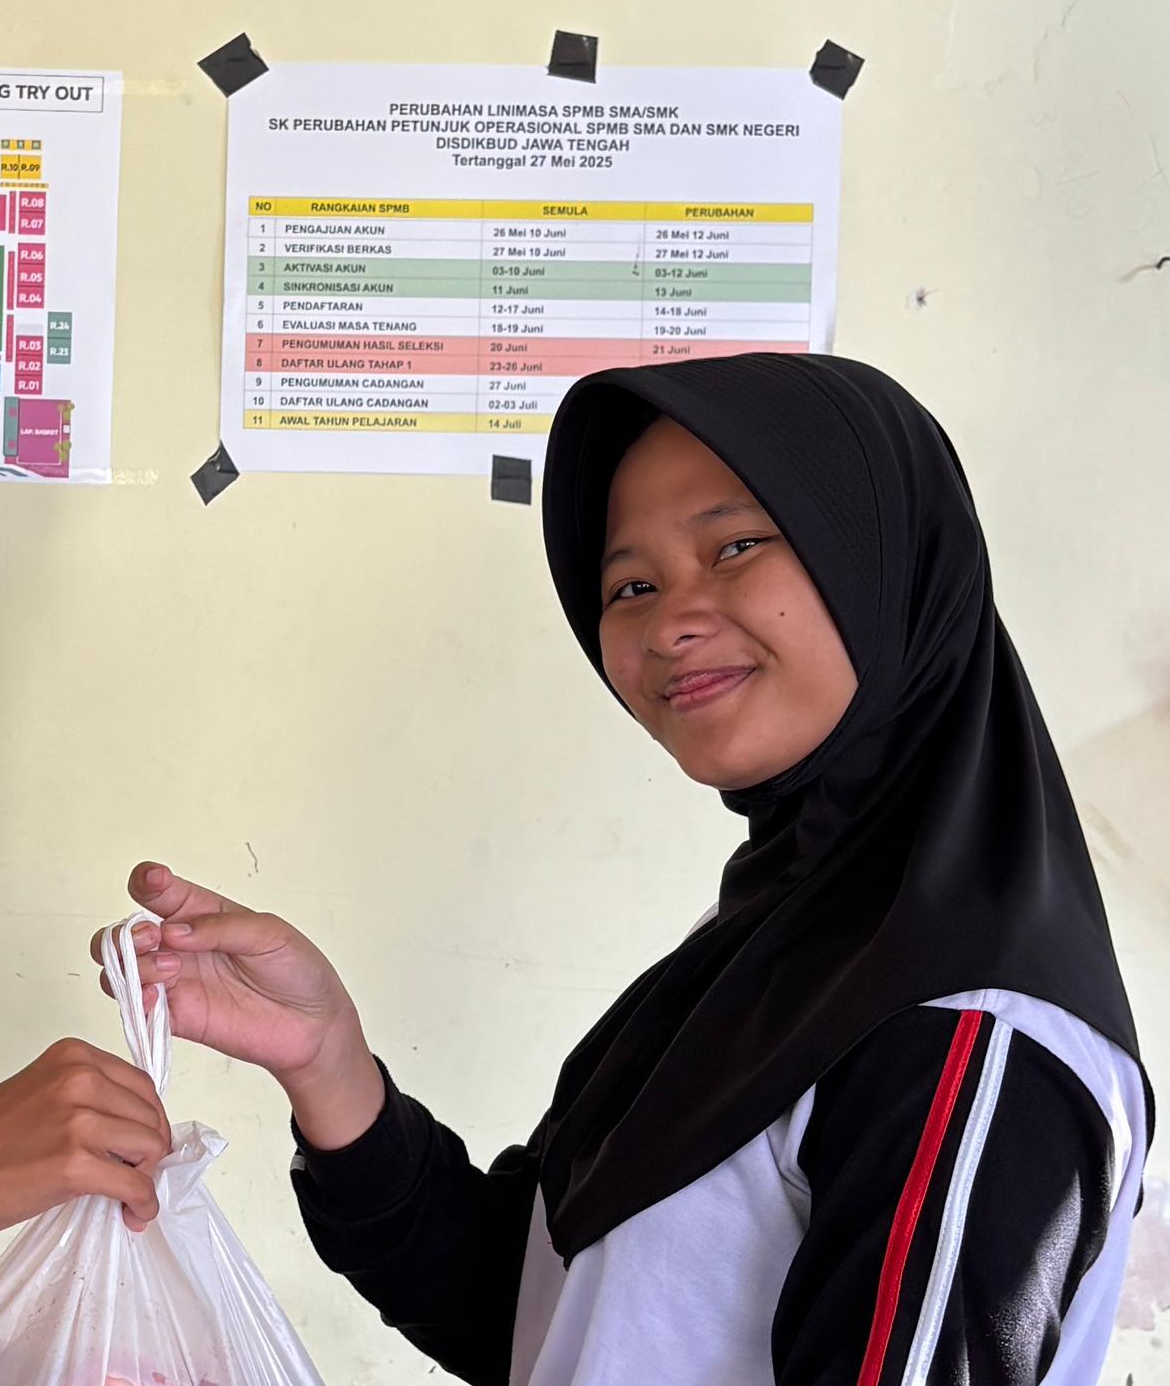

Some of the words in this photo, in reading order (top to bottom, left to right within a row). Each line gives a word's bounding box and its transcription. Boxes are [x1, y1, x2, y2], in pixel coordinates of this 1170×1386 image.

[16, 85, 49, 101] TRY
[55, 86, 93, 102] OUT
[389, 103, 483, 117] PERUBAHAN
[487, 105, 558, 118] LINIMASA
[562, 106, 605, 119] SPMB
[609, 106, 679, 120] SMA/SMK
[268, 118, 289, 131] SK
[293, 119, 386, 133] PERUBAHAN
[391, 120, 470, 134] PETUNJUK
[474, 121, 582, 135] OPERASIONAL
[586, 122, 629, 135] SPMB
[633, 123, 666, 136] SMA
[670, 124, 702, 136] DAN
[706, 124, 739, 137] SMK
[742, 124, 800, 138] NEGERI
[436, 137, 518, 150] DISDIKBUD
[522, 138, 563, 151] JAWA
[568, 139, 630, 152] TENGAH
[452, 154, 526, 170] Tertanggal
[530, 156, 547, 168] 27
[551, 156, 575, 168] Mei
[579, 156, 613, 169] 2025
[1, 163, 18, 172] R.10
[21, 163, 40, 172] R.09
[21, 198, 44, 207] R.08
[255, 202, 271, 211] NO
[311, 203, 376, 213] RANGKAIAN
[379, 203, 410, 213] SPMB
[543, 206, 588, 216] SEMULA
[685, 208, 754, 218] PERUBAHAN
[21, 219, 43, 228] R.07
[260, 225, 265, 233] 1
[285, 225, 351, 235] PENGAJUAN
[354, 226, 385, 235] AKUN
[494, 229, 505, 237] 26
[508, 229, 527, 238] Mei
[530, 229, 541, 238] 10
[543, 229, 566, 239] Juni
[656, 231, 669, 240] 26
[671, 231, 690, 240] Mei
[693, 231, 704, 240] 12
[706, 231, 729, 241] Juni
[259, 244, 265, 252] 2
[284, 244, 344, 254] VERIFIKASI
[347, 245, 392, 254] BERKAS
[493, 248, 505, 256] 27
[508, 248, 527, 257] Mei
[530, 248, 540, 257] 10
[542, 248, 566, 257] Juni
[20, 250, 43, 260] R.06
[655, 250, 668, 259] 27
[671, 250, 689, 259] Mei
[692, 250, 703, 259] 12
[705, 250, 728, 260] Juni
[258, 263, 264, 271] 3
[284, 264, 333, 273] AKTIVASI
[335, 264, 366, 273] AKUN
[492, 266, 519, 276] 03-10
[521, 267, 545, 277] Juni
[20, 273, 42, 282] R.05
[655, 269, 683, 278] 03-12
[685, 269, 708, 279] Juni
[283, 283, 360, 293] SINKRONISASI
[363, 284, 393, 293] AKUN
[492, 286, 503, 295] 11
[505, 286, 528, 295] Juni
[655, 288, 666, 297] 13
[668, 288, 692, 298] Juni
[19, 294, 41, 303] R.04
[258, 302, 264, 310] 5
[283, 302, 363, 311] PENDAFTARAN
[492, 305, 519, 314] 12-17
[521, 305, 544, 315] Juni
[654, 307, 681, 316] 14-18
[684, 307, 707, 317] Juni
[257, 320, 264, 329] 6
[282, 321, 335, 330] EVALUASI
[338, 322, 370, 331] MASA
[373, 322, 417, 331] TENANG
[492, 324, 518, 333] 18-19
[521, 324, 543, 334] Juni
[654, 326, 681, 335] 19-20
[683, 326, 706, 336] Juni
[256, 340, 263, 348] 7
[282, 340, 360, 350] PENGUMUMAN
[364, 341, 395, 350] HASIL
[398, 341, 443, 350] SELEKSI
[490, 343, 502, 352] 20
[504, 343, 527, 353] Juni
[653, 345, 665, 354] 21
[667, 345, 690, 355] Juni
[18, 362, 41, 371] R.02
[281, 359, 324, 368] DAFTAR
[327, 360, 365, 369] ULANG
[369, 360, 404, 369] TAHAP
[407, 361, 412, 369] 1
[490, 362, 517, 371] 23-26
[519, 362, 543, 372] Juni
[18, 381, 39, 390] R.01
[255, 378, 262, 387] 9
[281, 378, 359, 388] PENGUMUMAN
[362, 379, 424, 389] CADANGAN
[489, 381, 501, 390] 27
[503, 381, 526, 391] Juni
[253, 397, 264, 406] 10
[280, 397, 323, 407] DAFTAR
[326, 398, 364, 407] ULANG
[367, 398, 429, 408] CADANGAN
[488, 400, 516, 410] 02-03
[519, 400, 538, 410] Juli
[253, 416, 263, 425] 11
[280, 417, 310, 425] AWAL
[313, 417, 349, 426] TAHUN
[352, 417, 417, 427] PELAJARAN
[489, 420, 500, 428] 14
[502, 420, 522, 429] Juli
